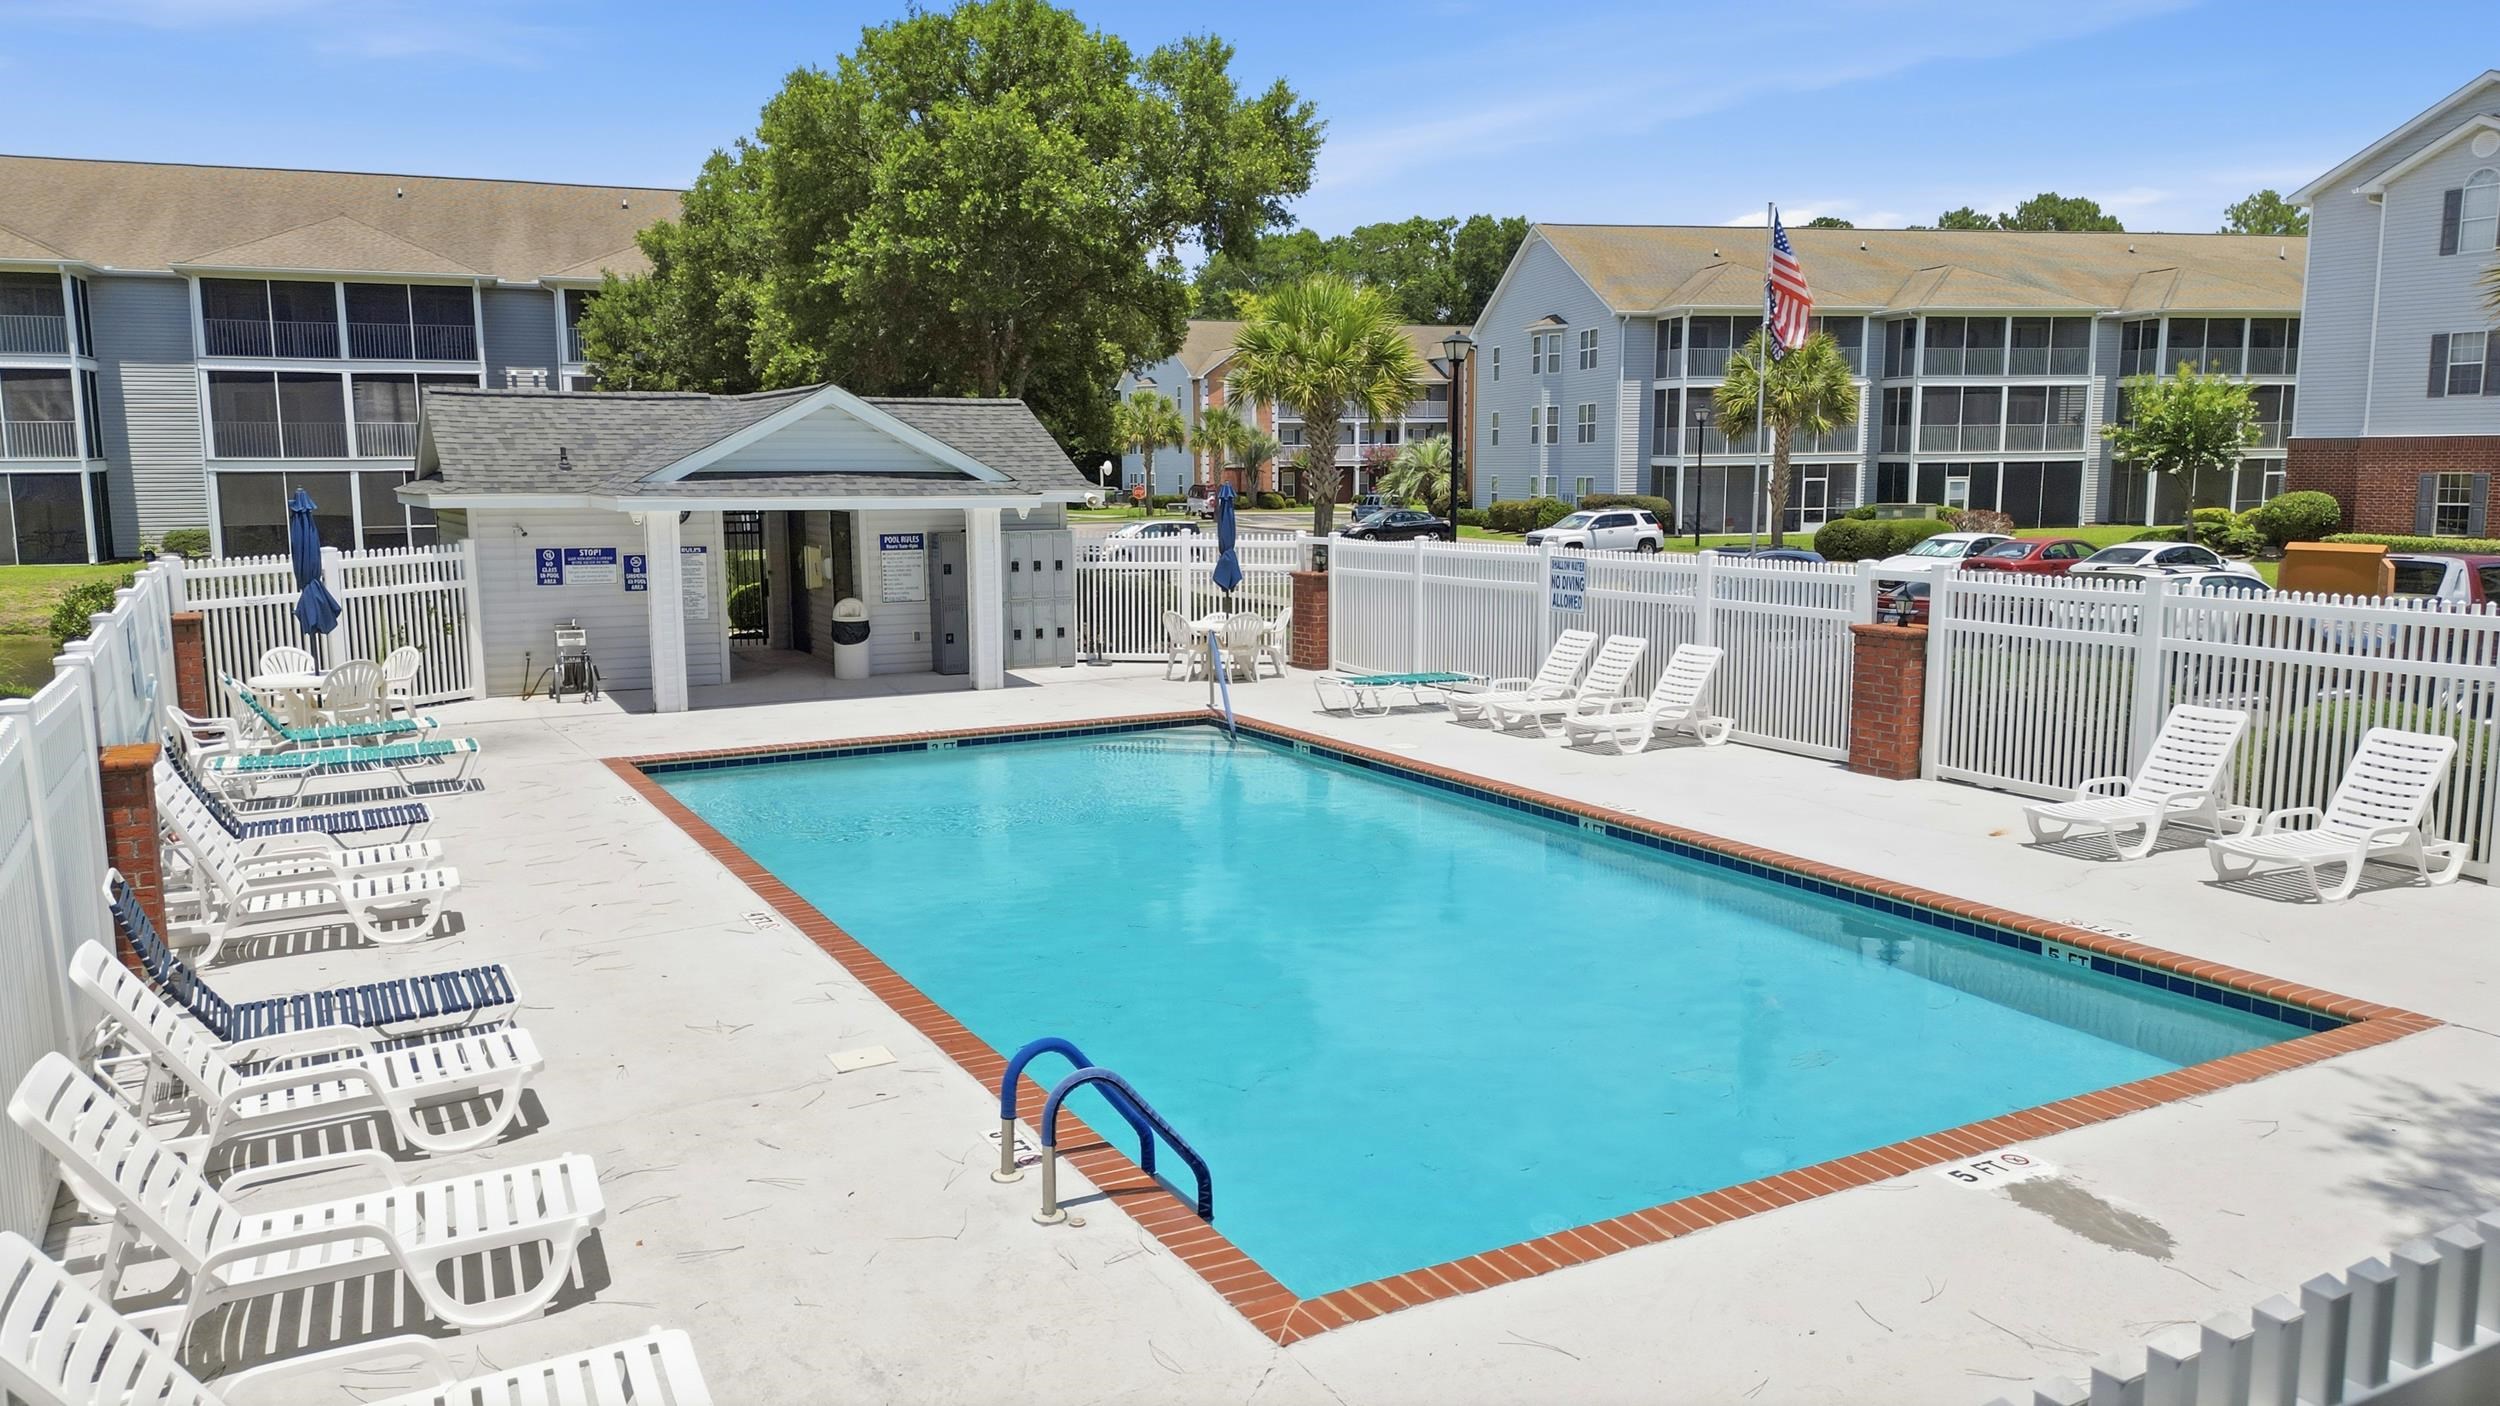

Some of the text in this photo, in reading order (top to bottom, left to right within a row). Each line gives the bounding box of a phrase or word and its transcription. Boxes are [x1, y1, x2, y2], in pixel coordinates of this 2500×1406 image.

[884, 535, 919, 543] POOL RULES
[1551, 560, 1585, 572] SHALLOW WATER
[1551, 574, 1584, 592] NO DIVING
[1551, 592, 1583, 609] ALLOWED
[2048, 946, 2089, 967] 5 FT
[1947, 1160, 2009, 1183] 5 FT
